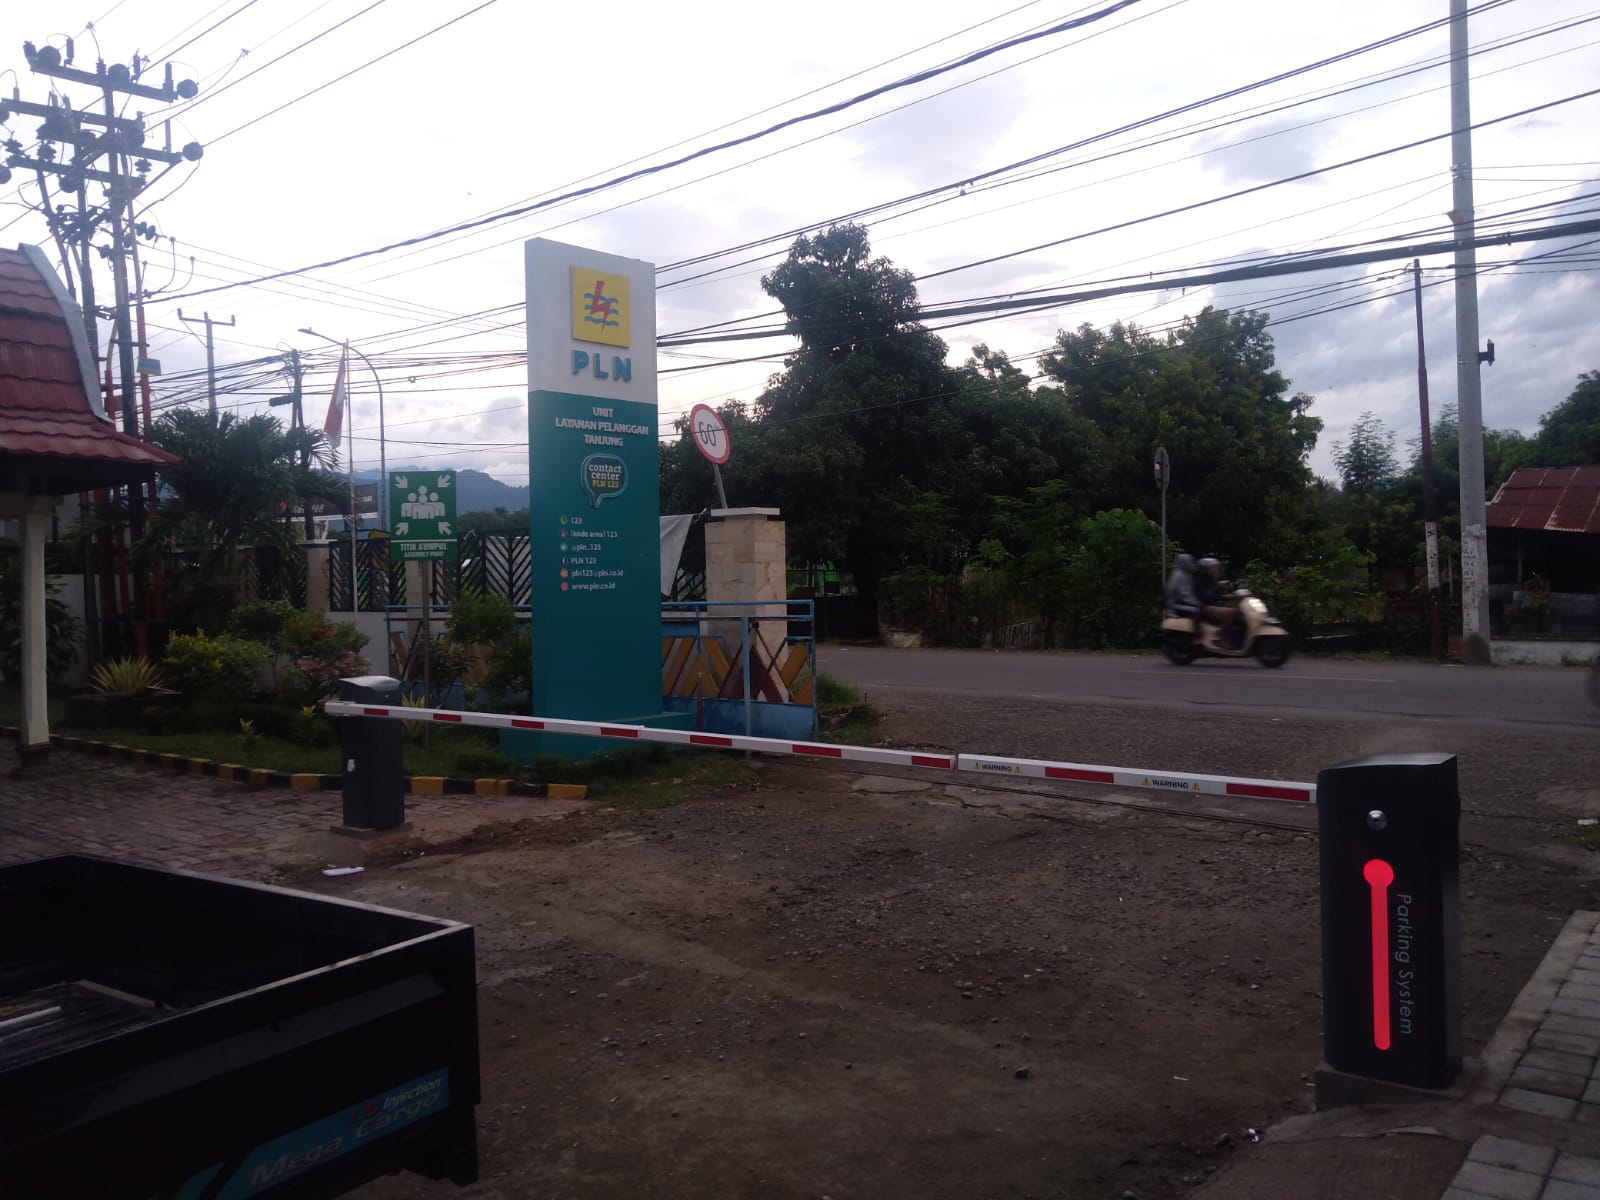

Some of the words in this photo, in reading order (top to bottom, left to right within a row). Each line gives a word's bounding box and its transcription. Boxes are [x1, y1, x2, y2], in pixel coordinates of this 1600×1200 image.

[572, 350, 632, 382] PLN
[592, 407, 614, 418] UNIT
[555, 417, 597, 431] LAYANAN
[598, 421, 649, 435] PELANGGAN
[698, 421, 717, 447] 60
[584, 434, 623, 447] TANJUNG
[588, 464, 622, 473] contact
[591, 472, 620, 481] center
[592, 480, 606, 488] PLN
[607, 480, 619, 489] 123
[606, 530, 618, 538] 123
[400, 543, 417, 551] TITIK
[418, 543, 448, 551] KUMPUL
[981, 763, 1012, 773] WARNING
[1152, 778, 1189, 790] WARNING
[1395, 894, 1413, 963] Parking
[1396, 969, 1415, 1034] System
[384, 1077, 442, 1109] Injection
[250, 1136, 343, 1189] Mega
[355, 1092, 440, 1138] Cargo
